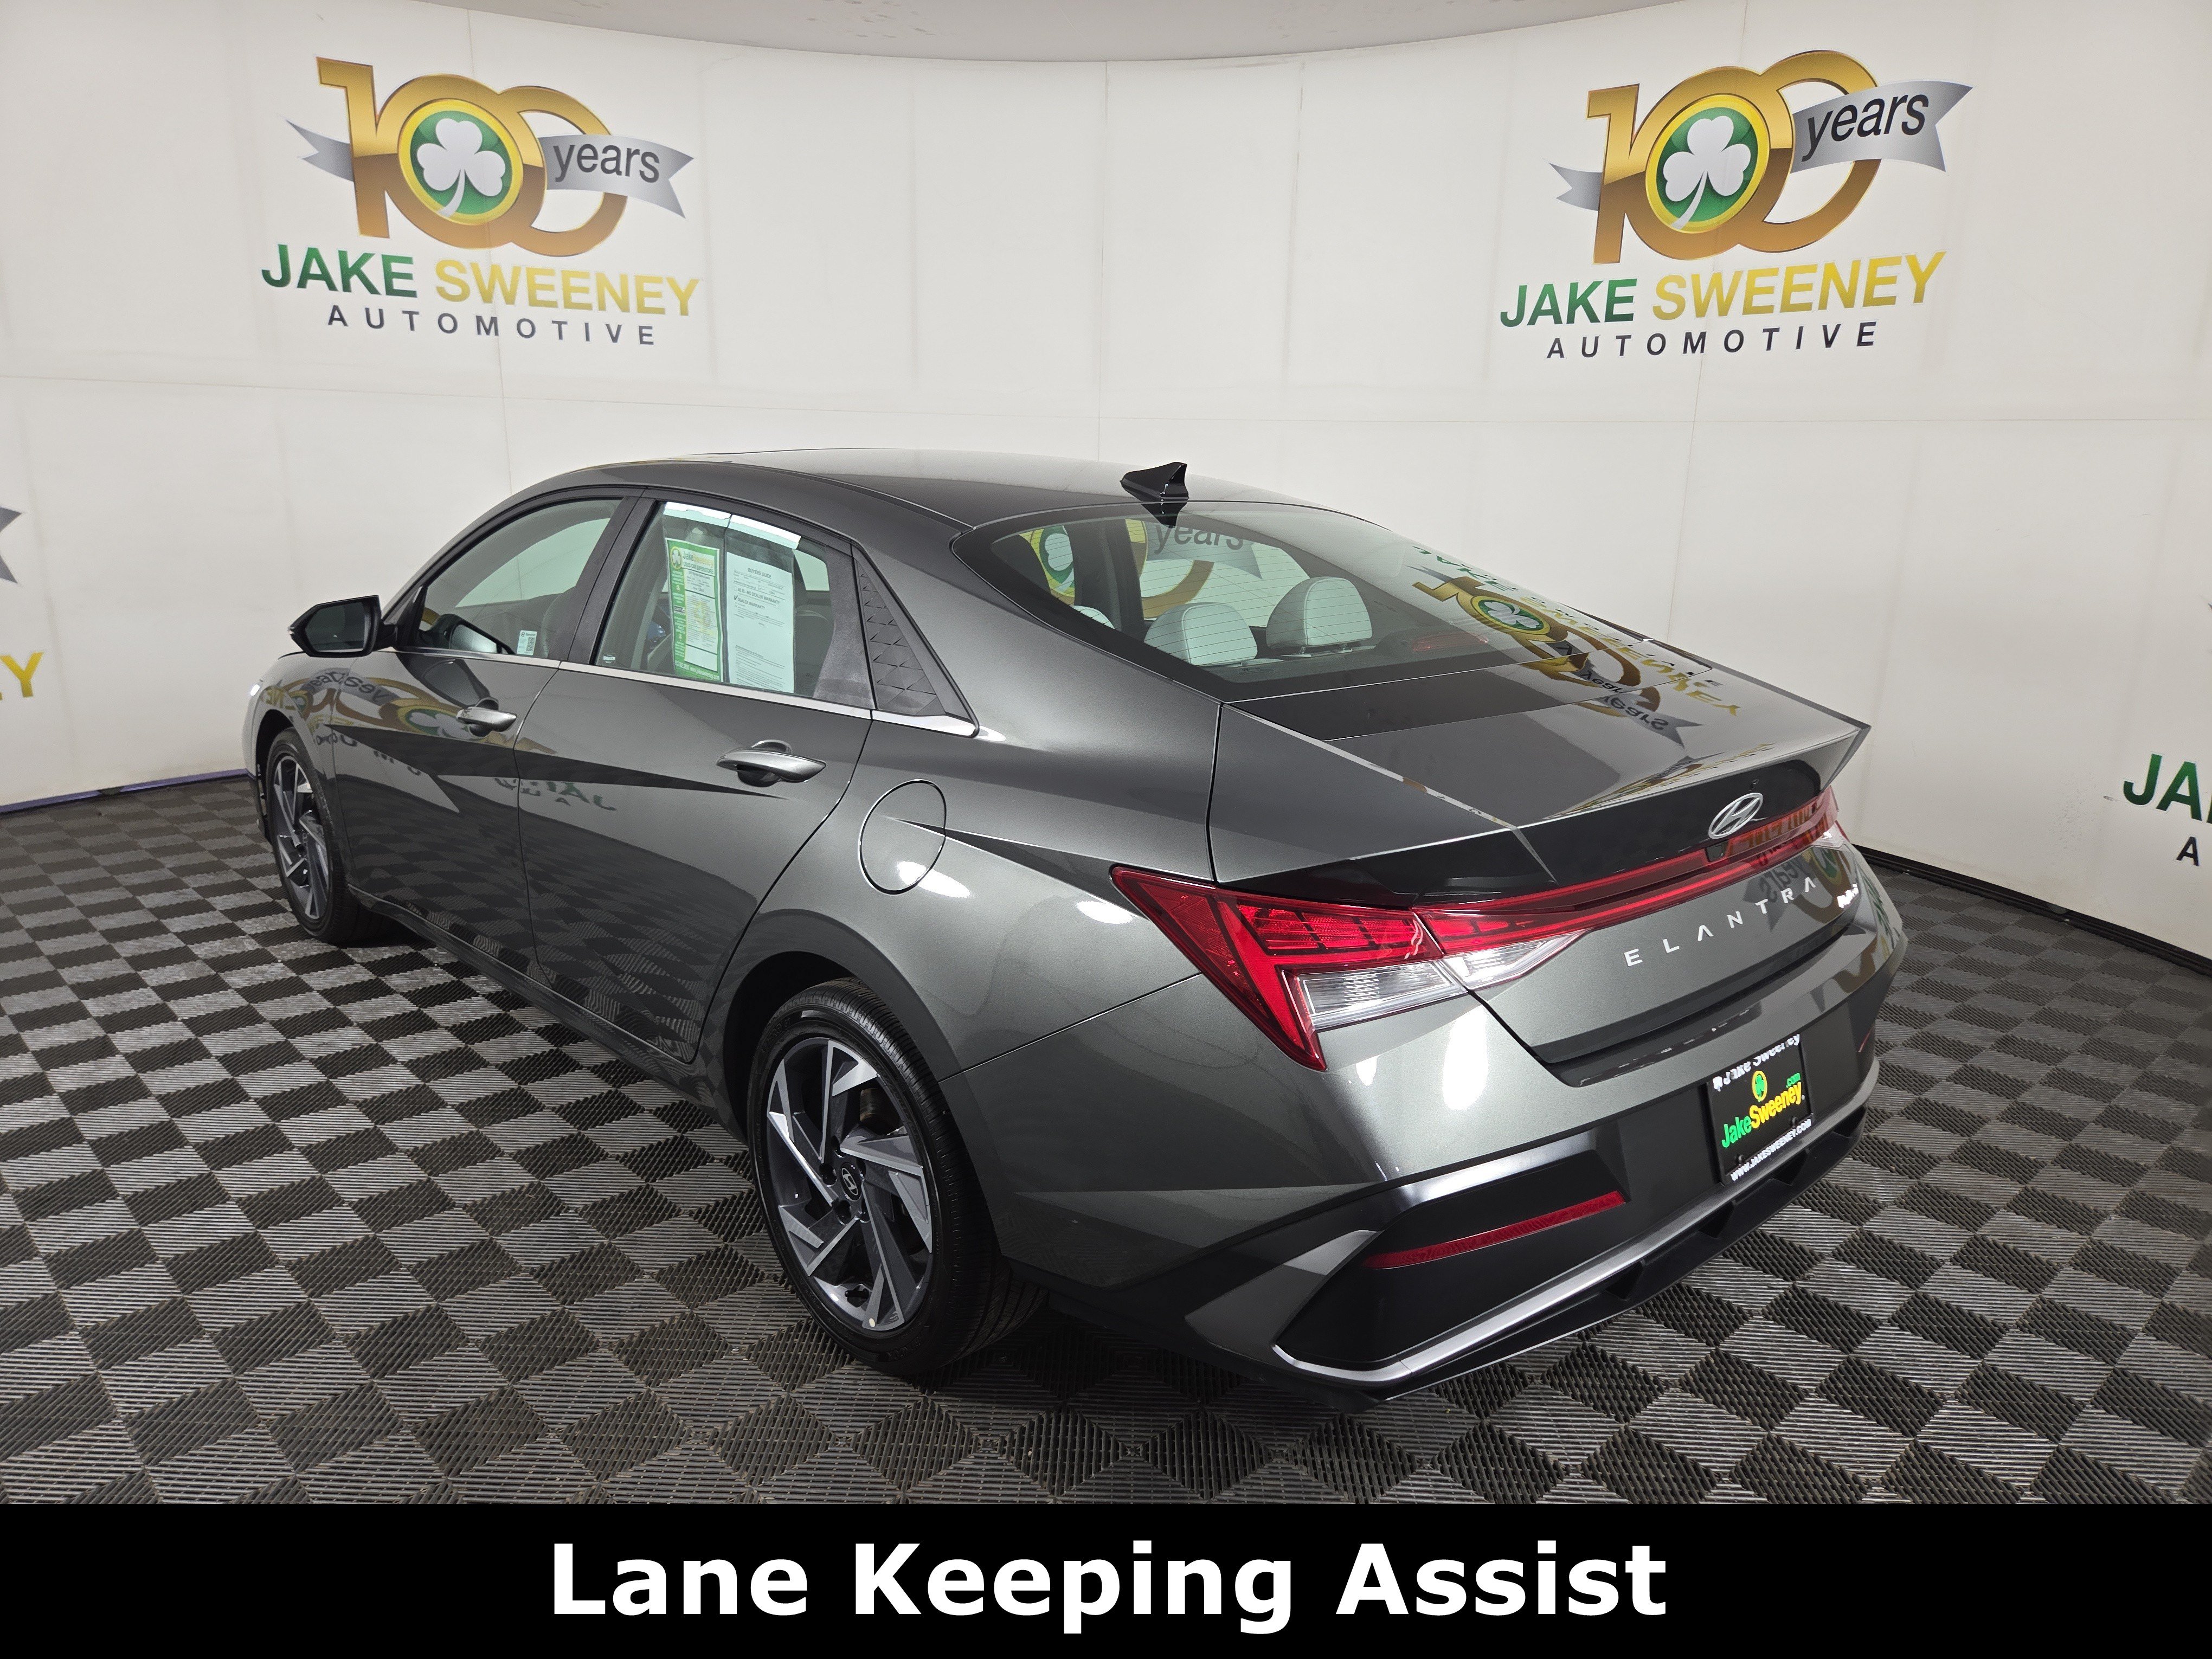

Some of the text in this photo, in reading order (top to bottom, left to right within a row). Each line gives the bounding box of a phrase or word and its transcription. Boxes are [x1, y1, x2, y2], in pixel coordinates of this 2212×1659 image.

[1801, 92, 1930, 163] years
[552, 142, 661, 183] years
[261, 244, 699, 316] JAKE SWEENEY
[1500, 251, 1947, 327] JAKE SWEENEY
[327, 305, 655, 345] AUTOMOTIVE
[1546, 321, 1877, 359] AUTOMOTIVE
[749, 601, 766, 610] WARRANTY
[763, 596, 780, 605] WARRANTY
[2123, 754, 2212, 825] JA
[1624, 877, 1816, 966] ELANTRA
